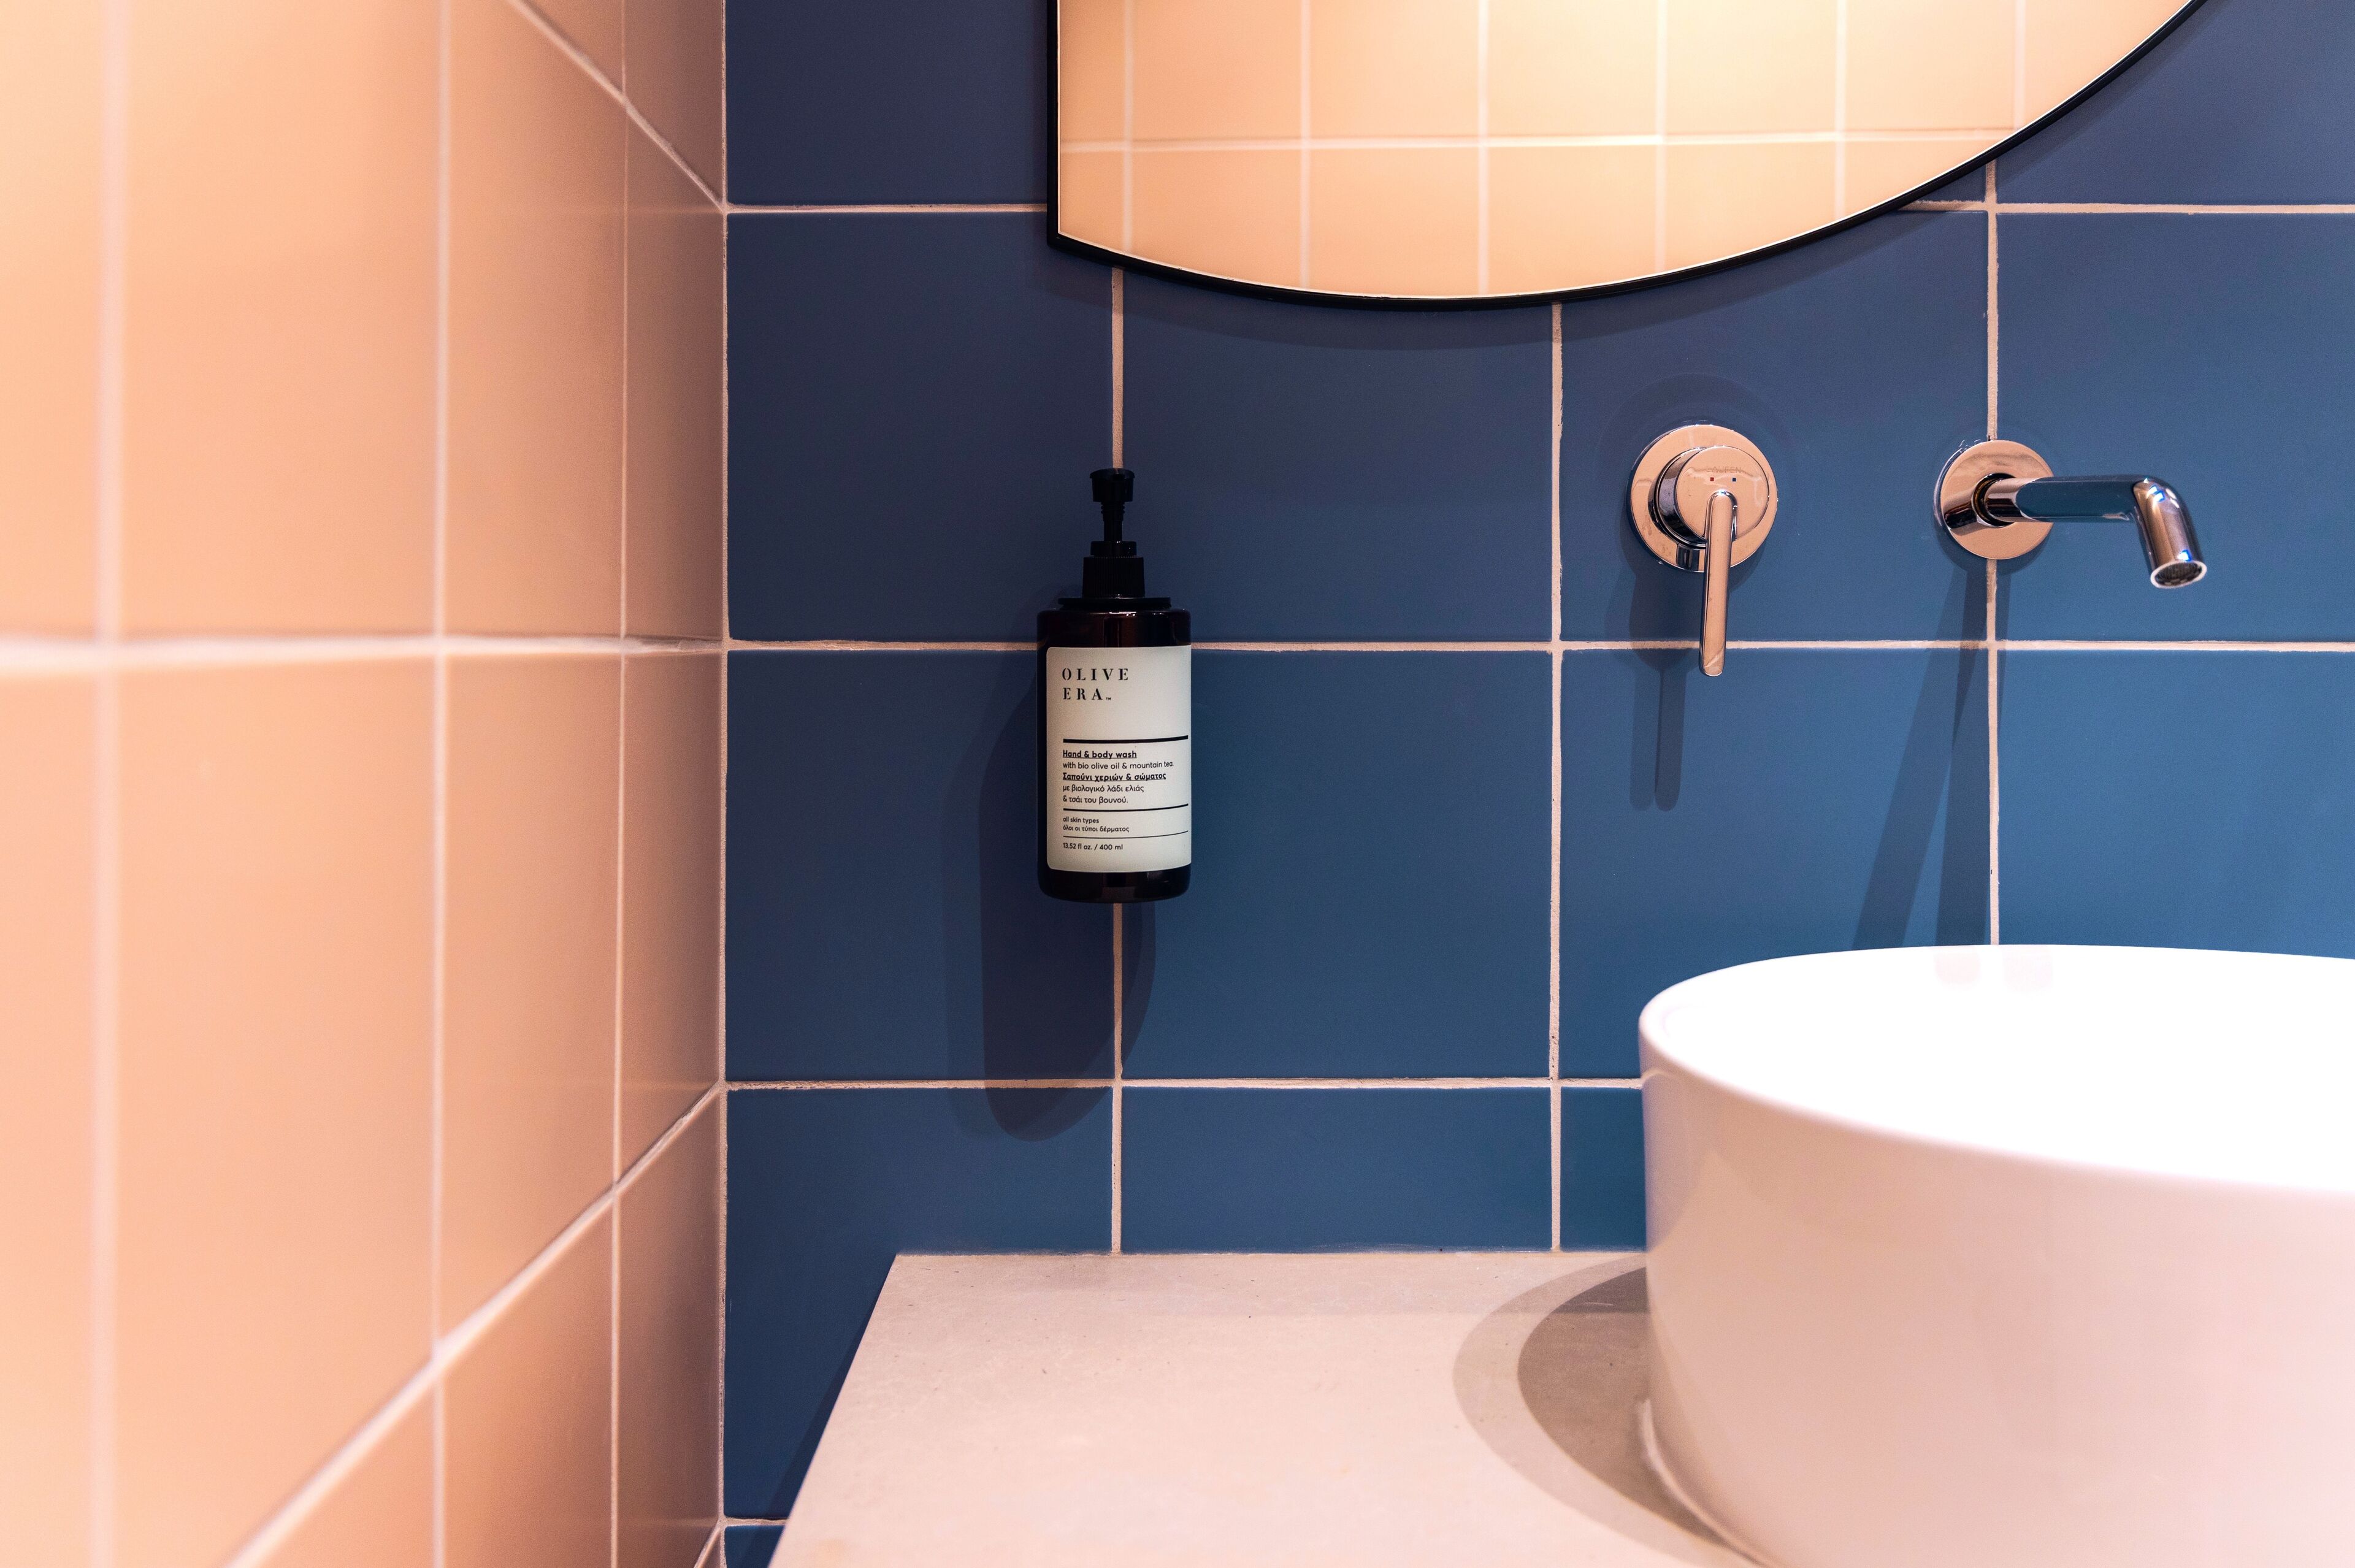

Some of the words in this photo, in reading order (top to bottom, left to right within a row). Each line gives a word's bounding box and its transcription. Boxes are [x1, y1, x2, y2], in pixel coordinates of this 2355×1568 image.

[1062, 668, 1128, 681] OLIVE
[1063, 749, 1082, 758] Hand
[1092, 751, 1113, 760] body
[1095, 773, 1123, 782] χεριών
[1071, 784, 1105, 793] βιολογικό
[1099, 796, 1128, 805] βουνού.
